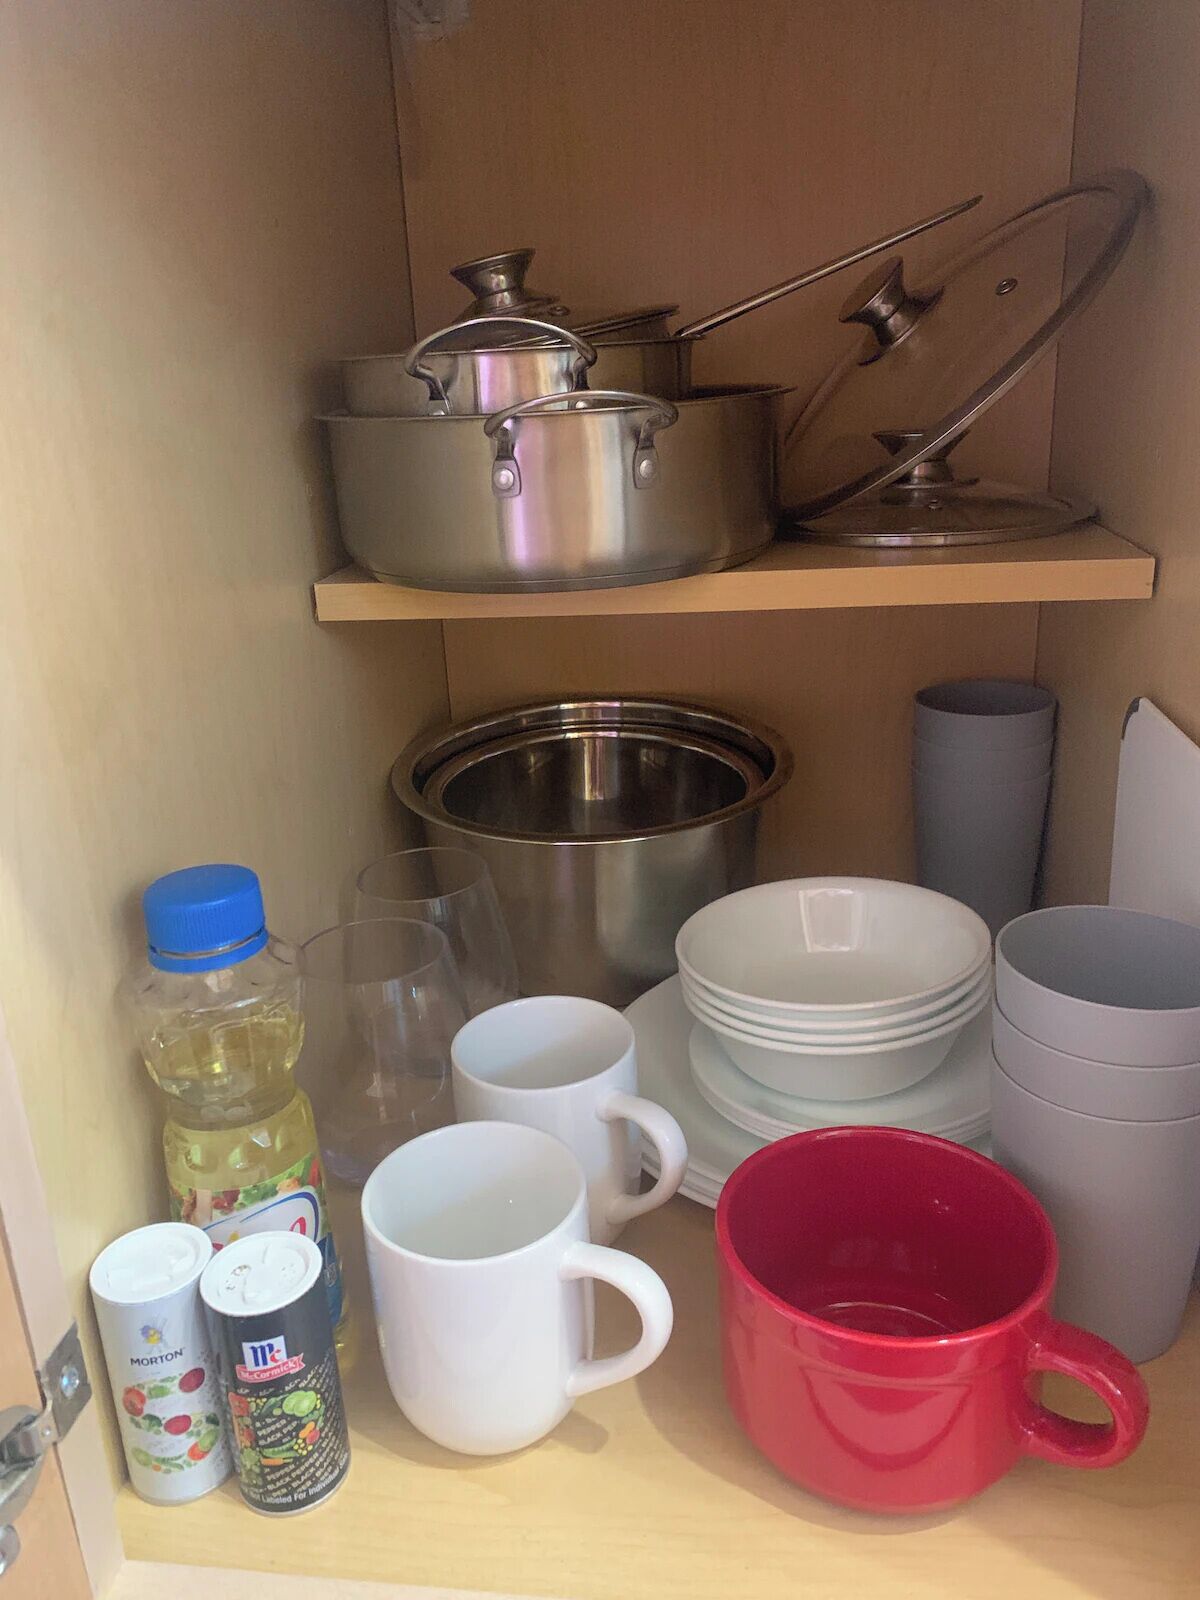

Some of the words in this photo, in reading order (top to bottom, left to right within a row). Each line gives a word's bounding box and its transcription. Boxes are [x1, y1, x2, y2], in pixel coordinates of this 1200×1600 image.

[130, 1348, 184, 1367] MORTON
[239, 1360, 297, 1380] McCormick
[256, 1418, 287, 1437] PEPPER
[260, 1493, 292, 1504] Labeled
[293, 1492, 307, 1502] For
